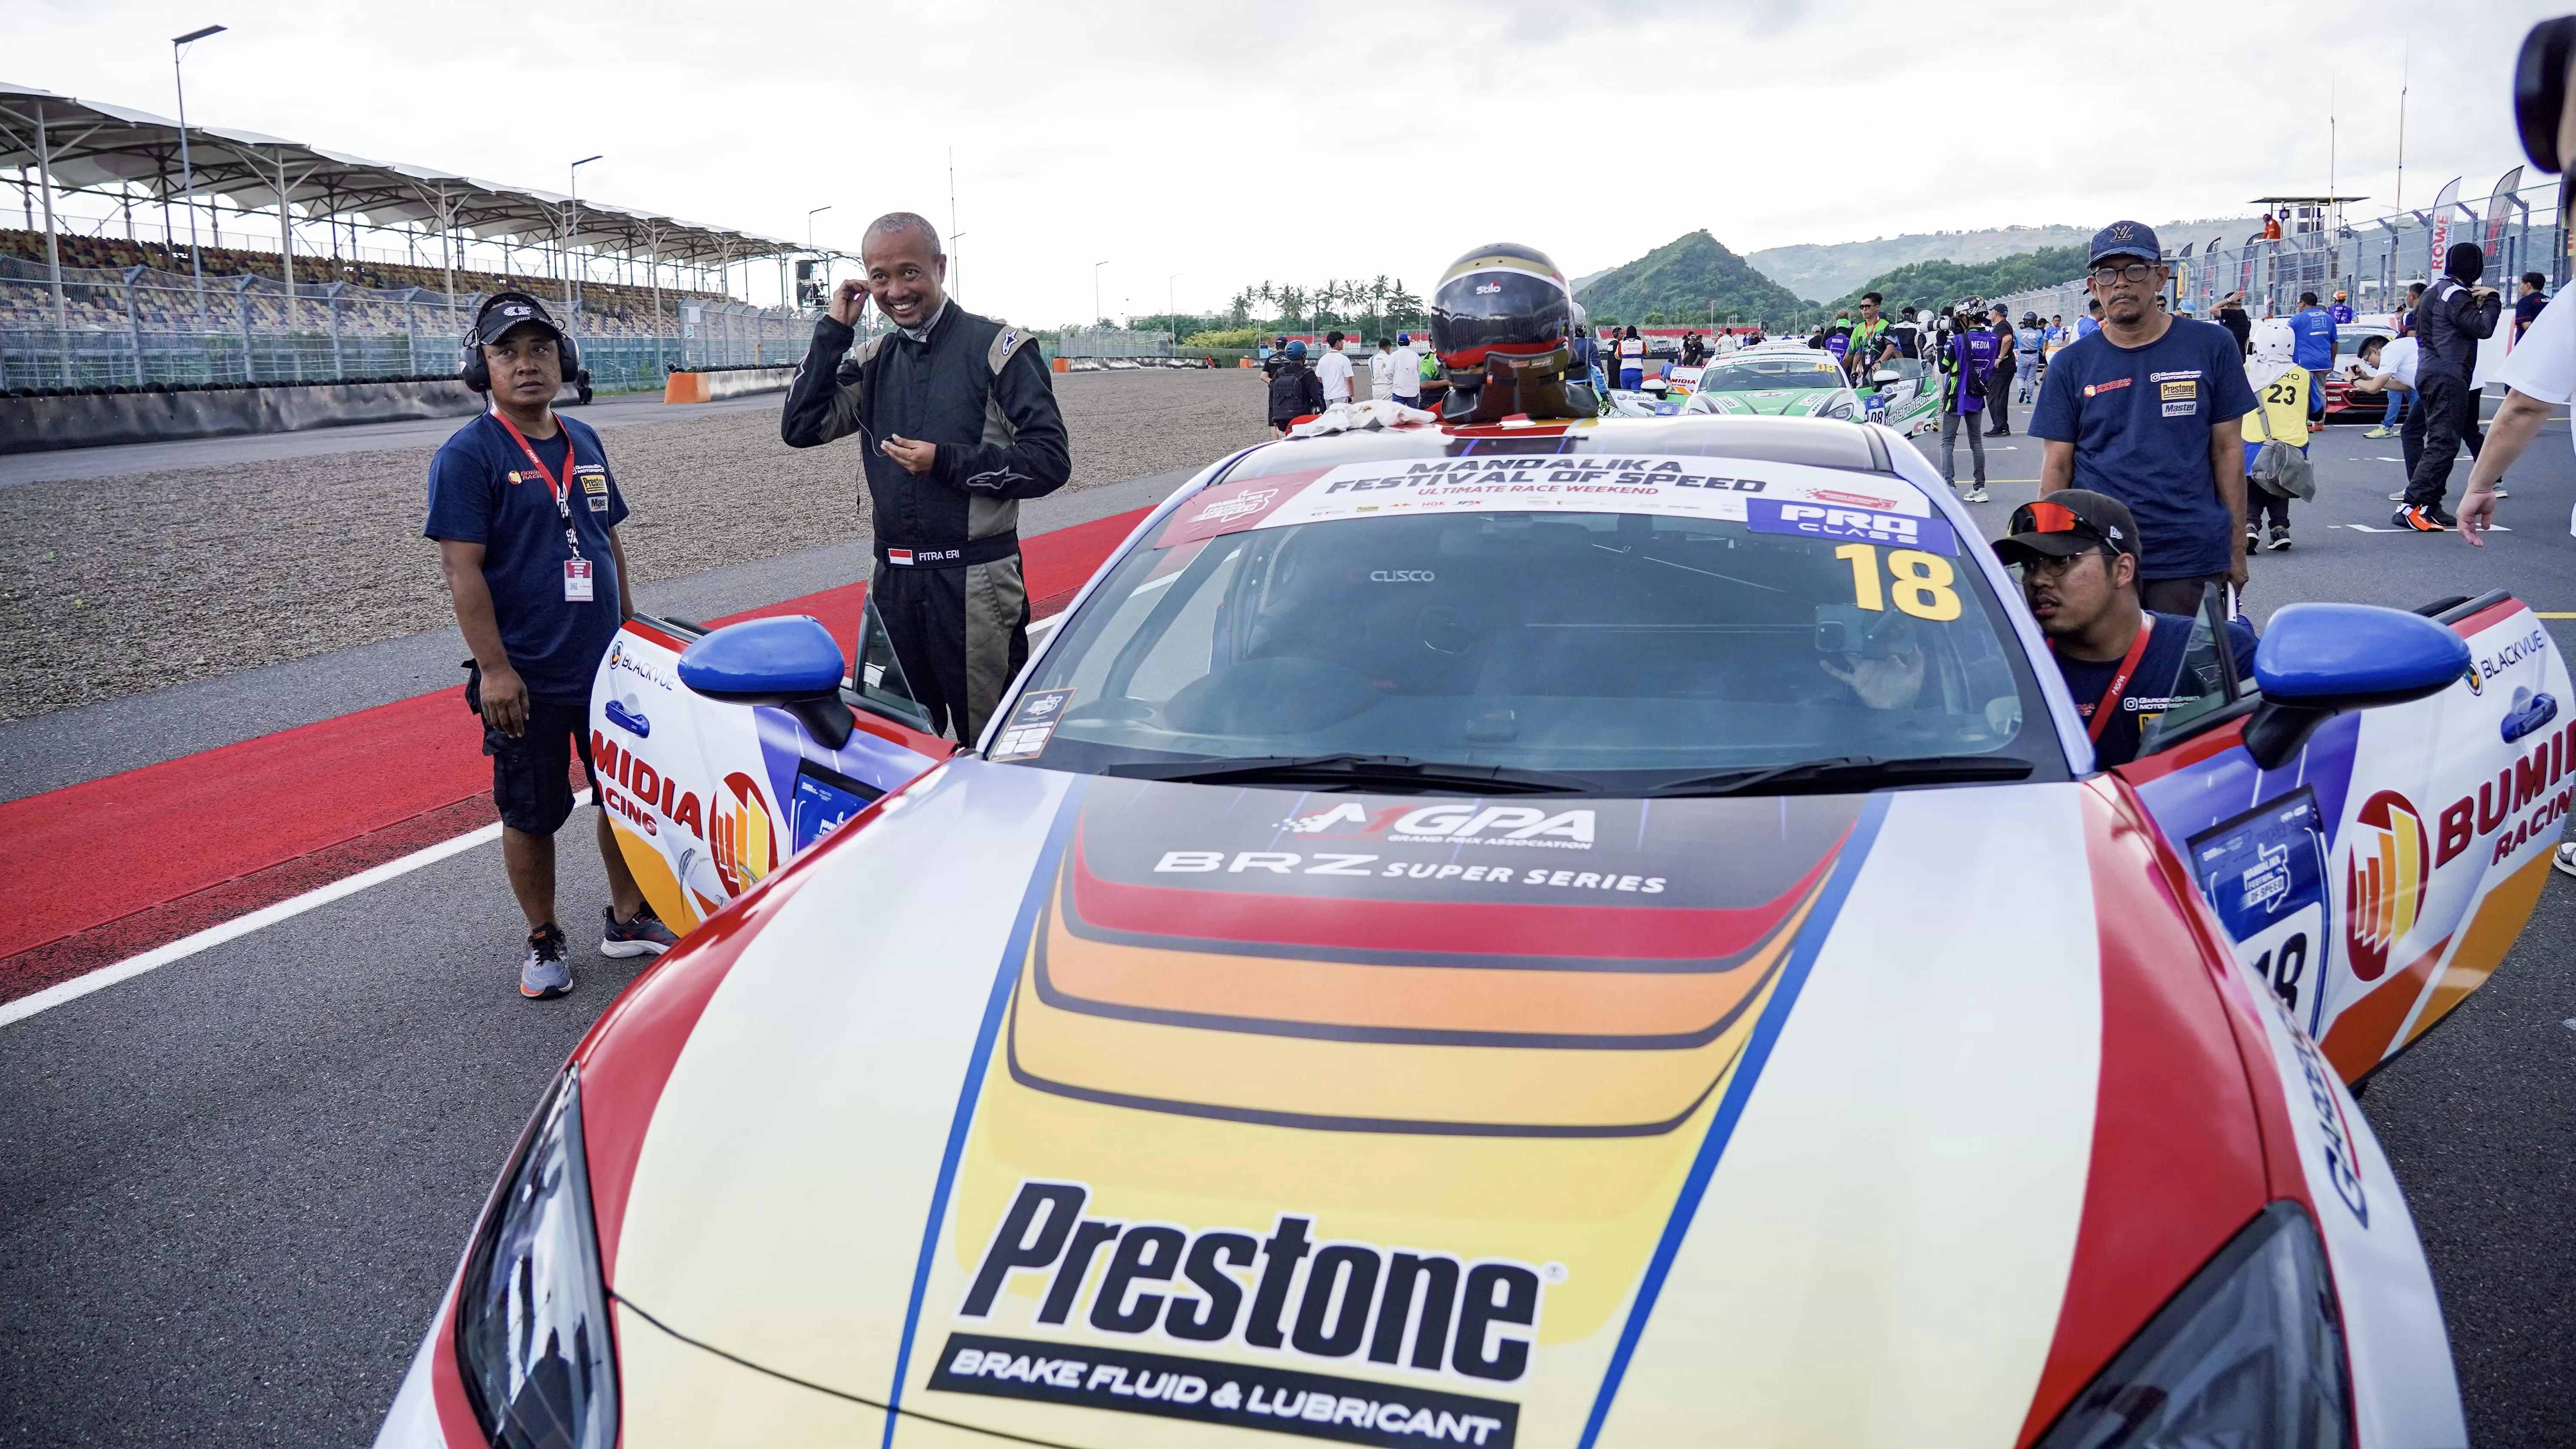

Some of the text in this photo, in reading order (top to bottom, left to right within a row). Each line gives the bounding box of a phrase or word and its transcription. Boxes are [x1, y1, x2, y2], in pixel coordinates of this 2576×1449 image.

[2432, 215, 2449, 270] ROWE
[499, 320, 516, 336] GRAND
[1971, 341, 1990, 350] MEDIA
[1816, 363, 1836, 373] 08
[2097, 382, 2131, 393] RACING
[2163, 384, 2194, 394] Prestone
[2267, 384, 2297, 405] 23
[2165, 403, 2196, 413] Master
[1871, 411, 1883, 425] 08
[1406, 459, 1683, 475] MANDALIKA
[1325, 471, 1766, 494] FESTIVAL OF SPEED
[1418, 485, 1659, 495] ULTIMATE RACE WEEKEND
[591, 499, 607, 507] Mas
[1781, 504, 1918, 535] PRO
[1798, 522, 1919, 544] CLASS
[919, 550, 960, 561] FITRA ERI
[1370, 570, 1435, 582] CUSCO
[1835, 543, 1962, 621] 18
[2480, 629, 2545, 680] BLACKVUE
[622, 652, 677, 691] BLACKVUE
[1387, 834, 1443, 843] GRAND
[1444, 836, 1481, 845] PRIX
[1483, 837, 1592, 850] ASSOCIATION
[1153, 851, 1668, 894] BRZ SUPER SERIES
[2243, 855, 2282, 887] MANDALIKA
[2248, 872, 2275, 890] FESTIVAL
[2250, 879, 2284, 903] OF SPEED
[957, 1179, 1542, 1385] Prestone
[949, 1348, 1502, 1445] BRAKE FLUID & LUBRICANT
